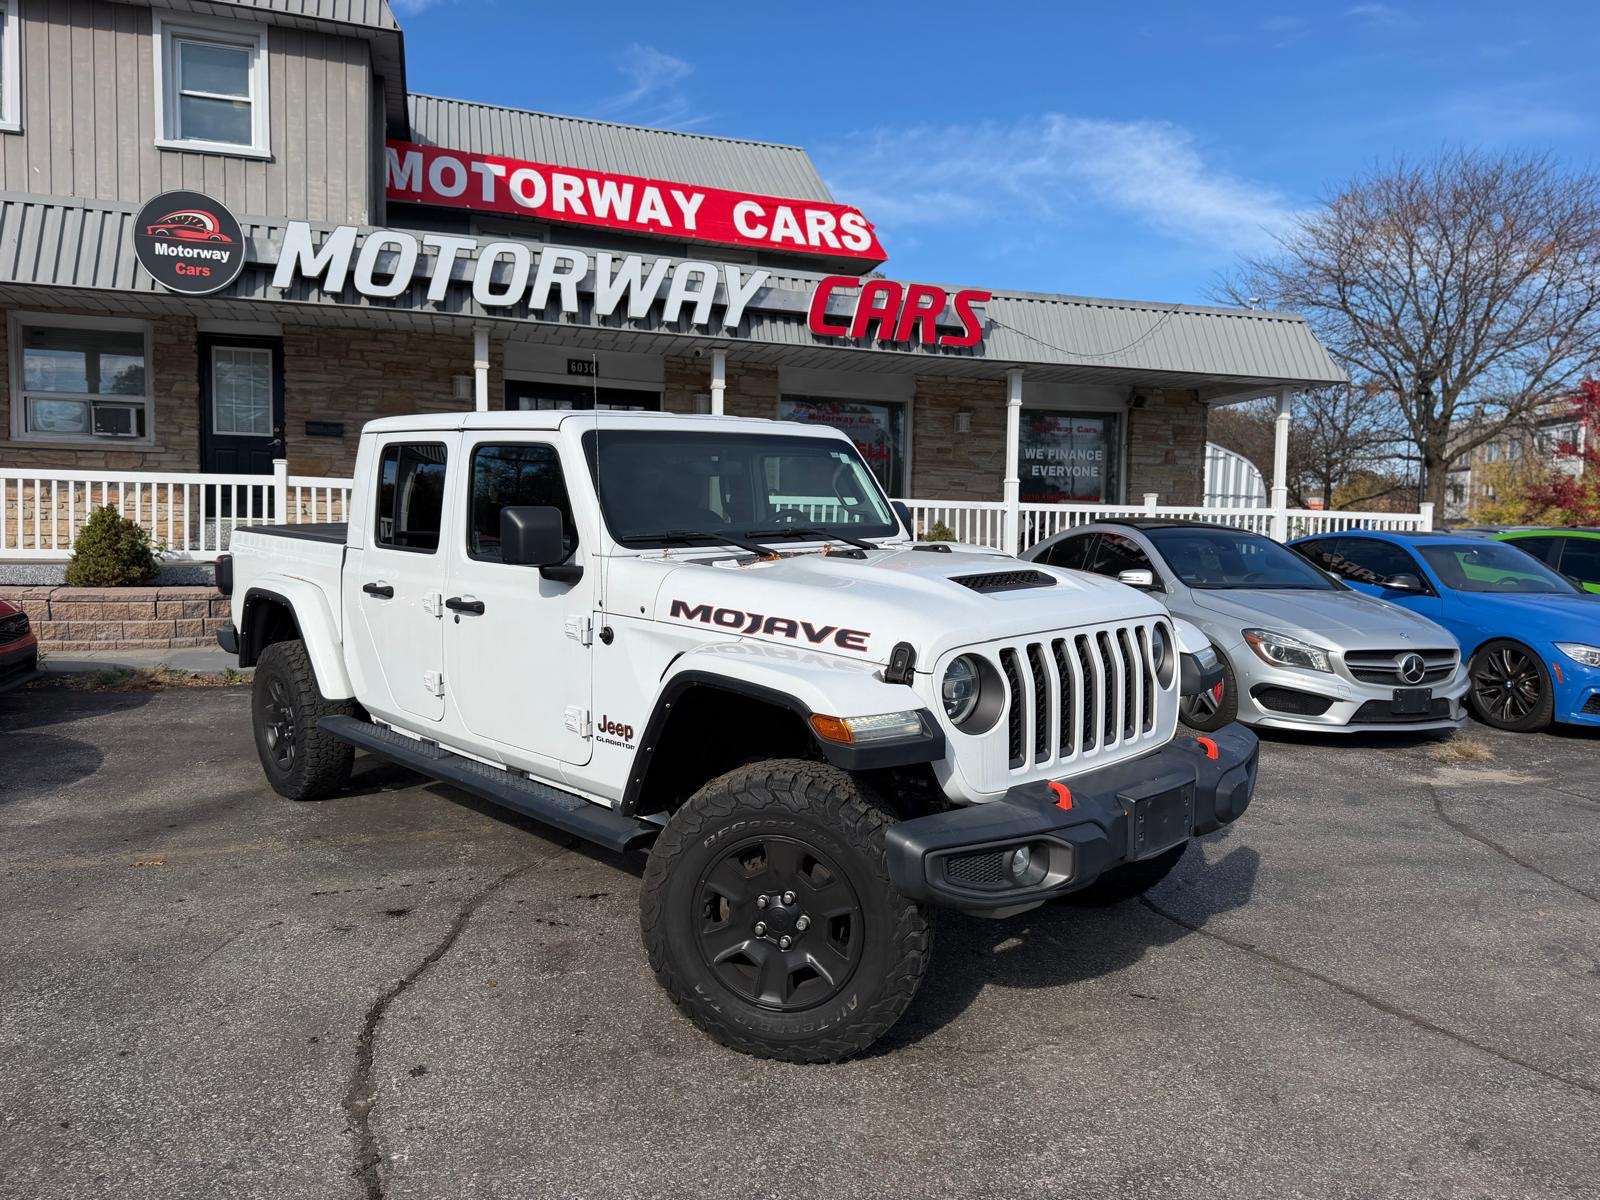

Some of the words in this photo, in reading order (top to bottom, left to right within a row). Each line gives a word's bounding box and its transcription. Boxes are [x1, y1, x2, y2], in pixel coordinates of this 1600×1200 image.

[386, 147, 705, 230] MOTORWAY
[733, 200, 872, 251] CARS
[154, 242, 230, 263] Motorway
[175, 262, 211, 277] Cars
[272, 221, 772, 327] MOTORWAY
[807, 276, 992, 347] CARS
[1077, 426, 1098, 434] Cars
[1024, 448, 1045, 460] WE
[1048, 449, 1103, 461] FINANCE
[1031, 465, 1100, 477] EVERYONE
[669, 599, 871, 652] MOJAVE
[597, 714, 634, 742] Jeep
[596, 735, 636, 750] GLADIATOR
